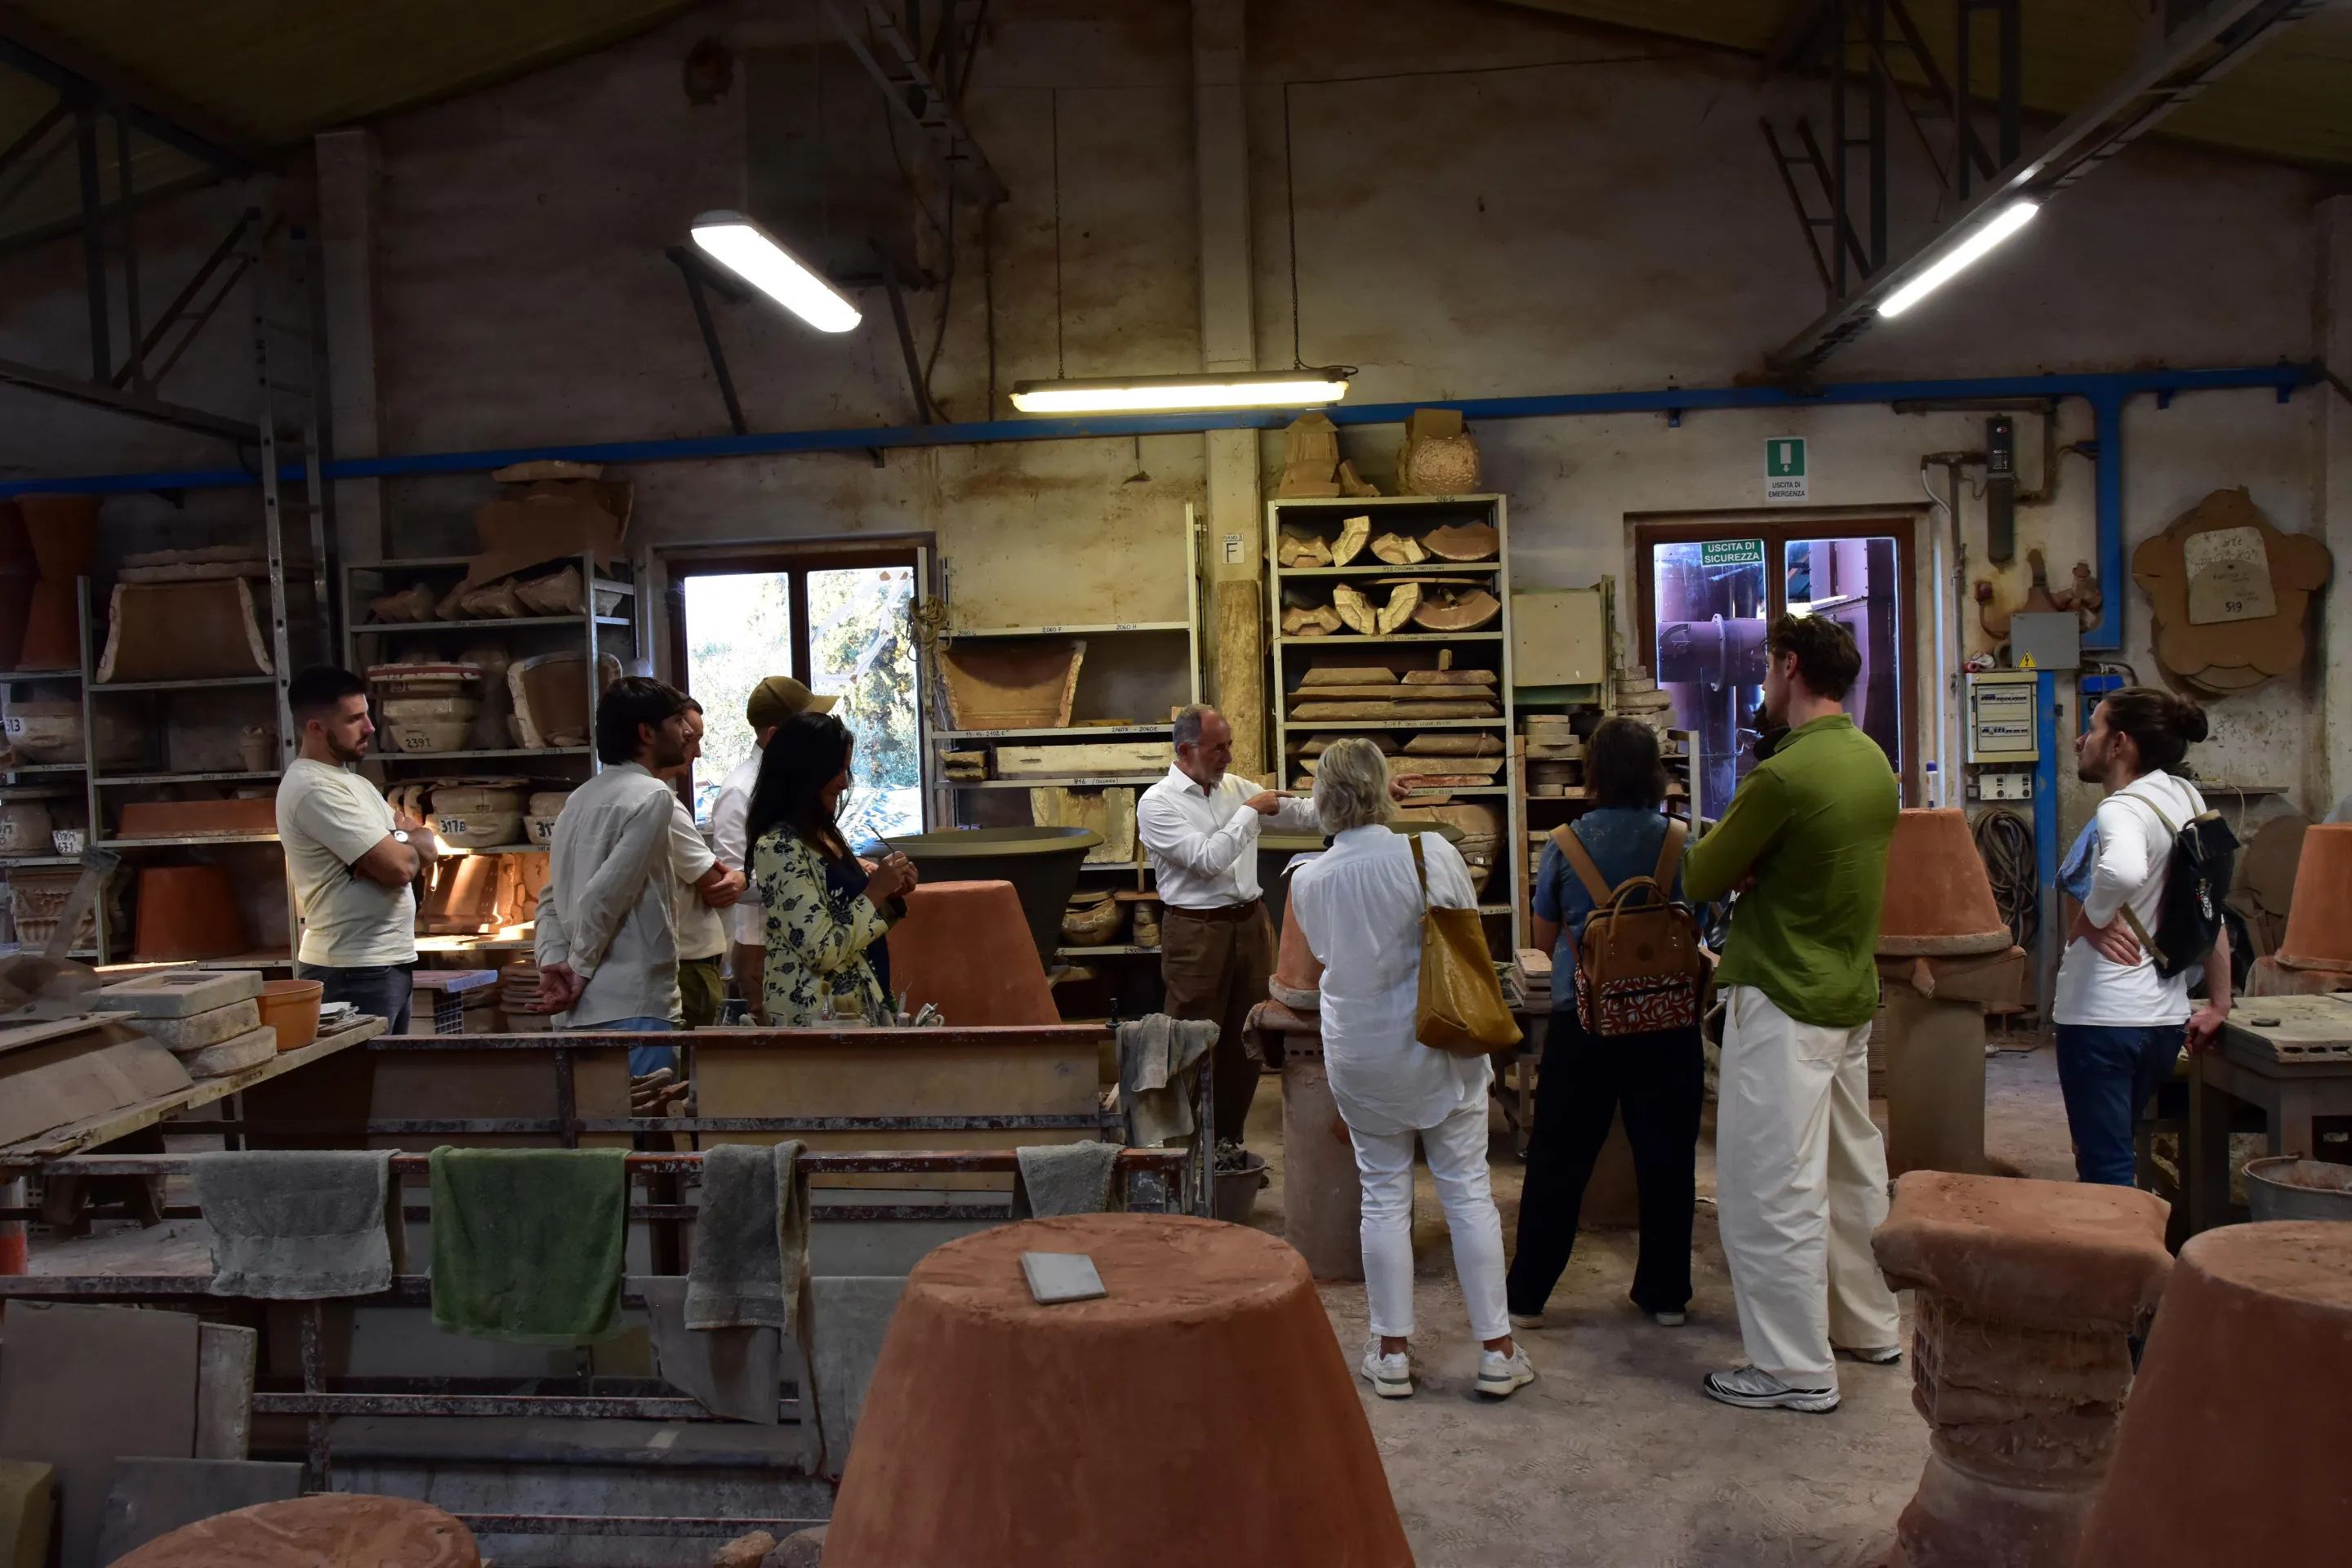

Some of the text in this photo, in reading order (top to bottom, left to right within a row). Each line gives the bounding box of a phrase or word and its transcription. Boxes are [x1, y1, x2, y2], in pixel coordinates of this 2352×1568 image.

[1226, 542, 1238, 563] F
[1708, 541, 1755, 553] USCITA DI
[1704, 552, 1760, 564] SICUREZZA
